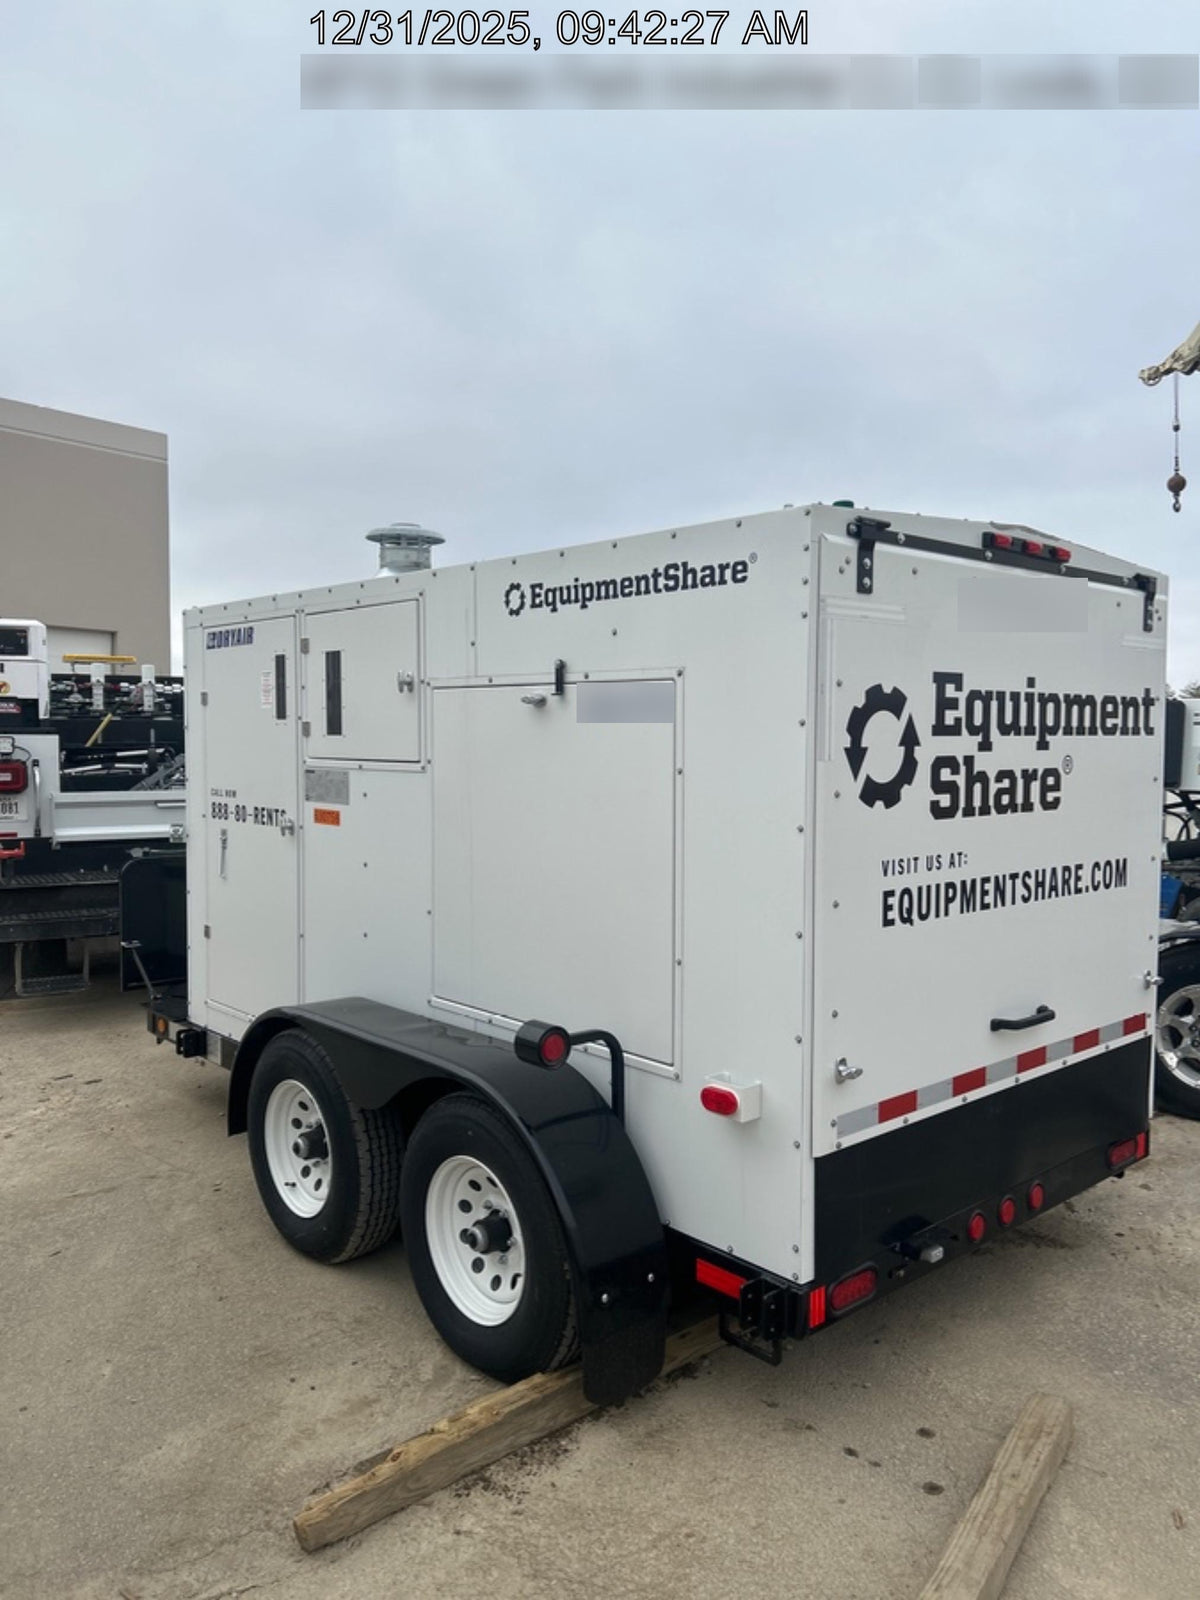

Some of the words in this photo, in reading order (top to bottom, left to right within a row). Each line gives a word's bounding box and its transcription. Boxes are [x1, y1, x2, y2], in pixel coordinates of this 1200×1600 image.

[931, 672, 1155, 751] Equipment
[881, 857, 919, 877] VISIT
[926, 854, 942, 871] US
[948, 851, 968, 868] AT:
[882, 858, 1128, 928] EQUIPMENTSHARE.COM
